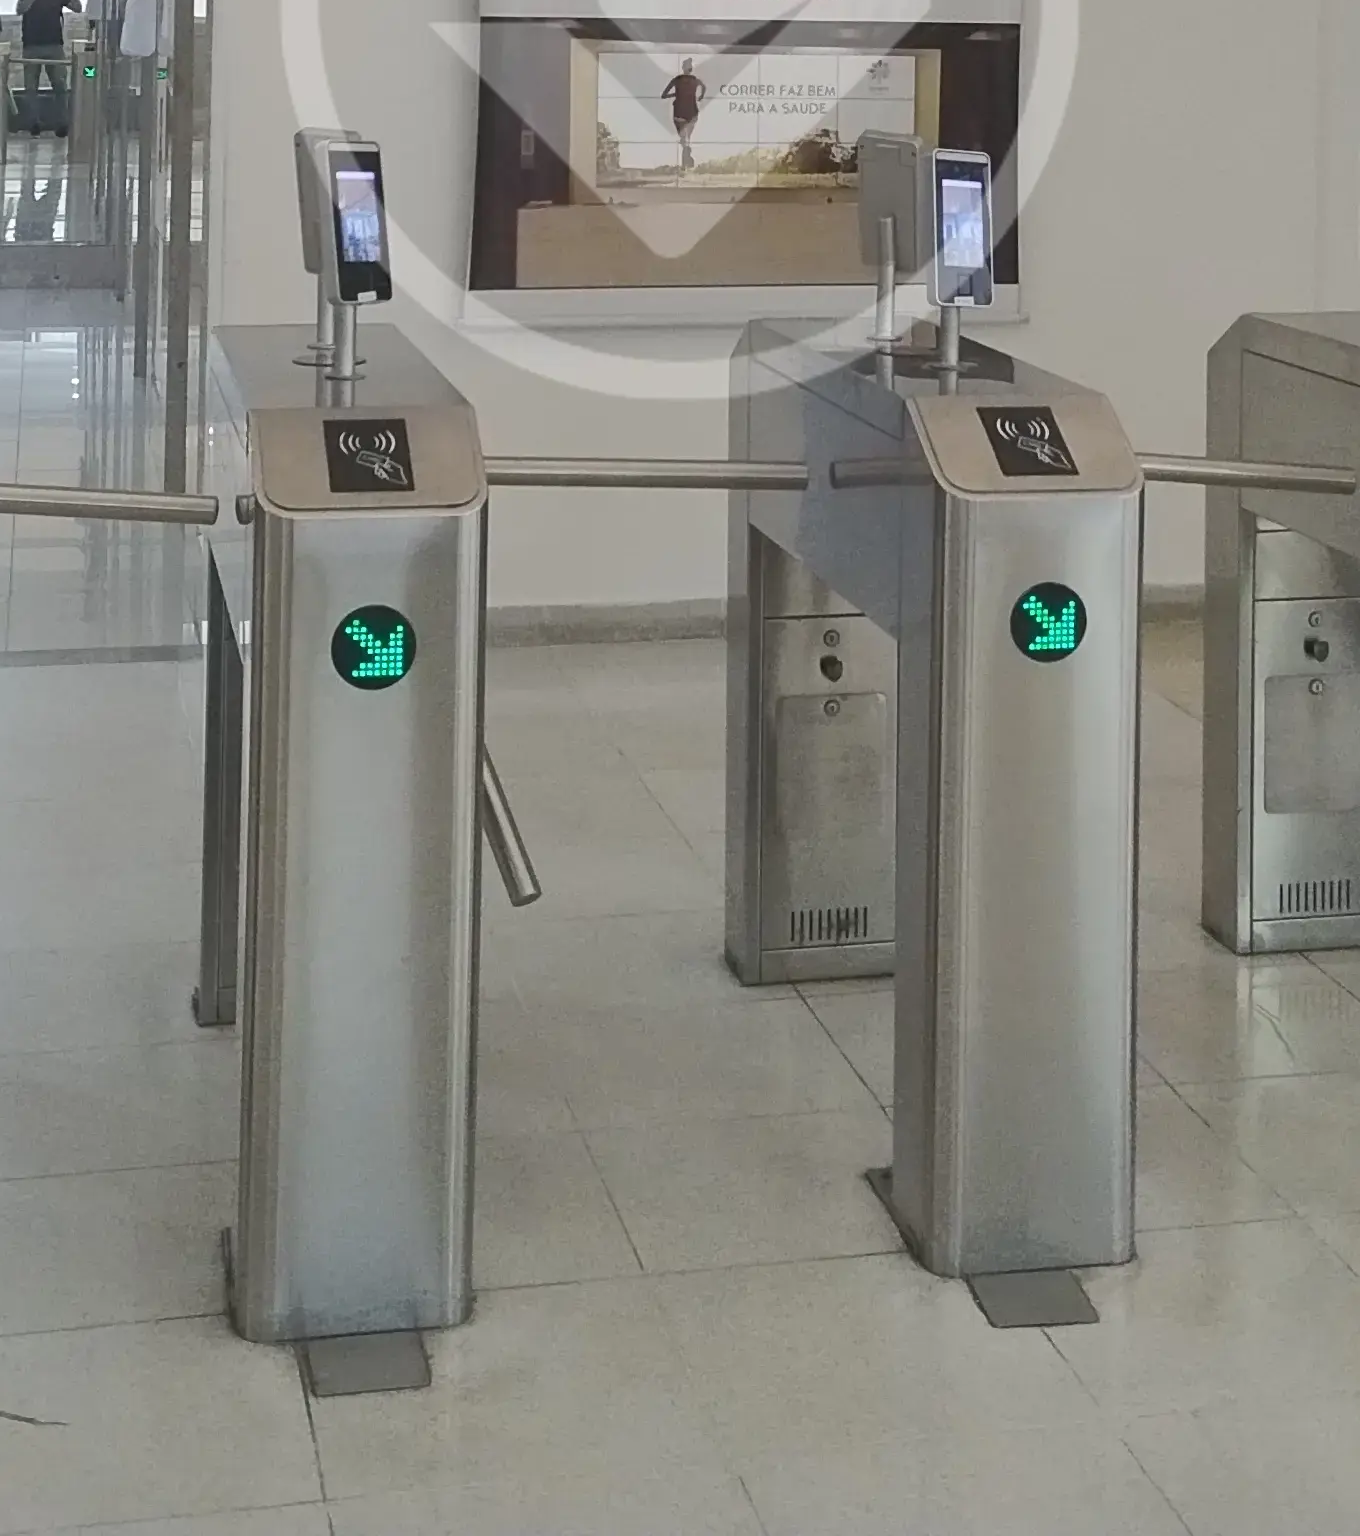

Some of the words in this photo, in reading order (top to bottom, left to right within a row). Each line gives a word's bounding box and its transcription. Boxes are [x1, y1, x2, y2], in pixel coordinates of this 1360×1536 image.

[720, 84, 775, 97] CORRER
[779, 84, 804, 97] FAZ
[808, 85, 836, 97] BEM
[729, 101, 765, 114] PARA
[768, 103, 778, 114] A
